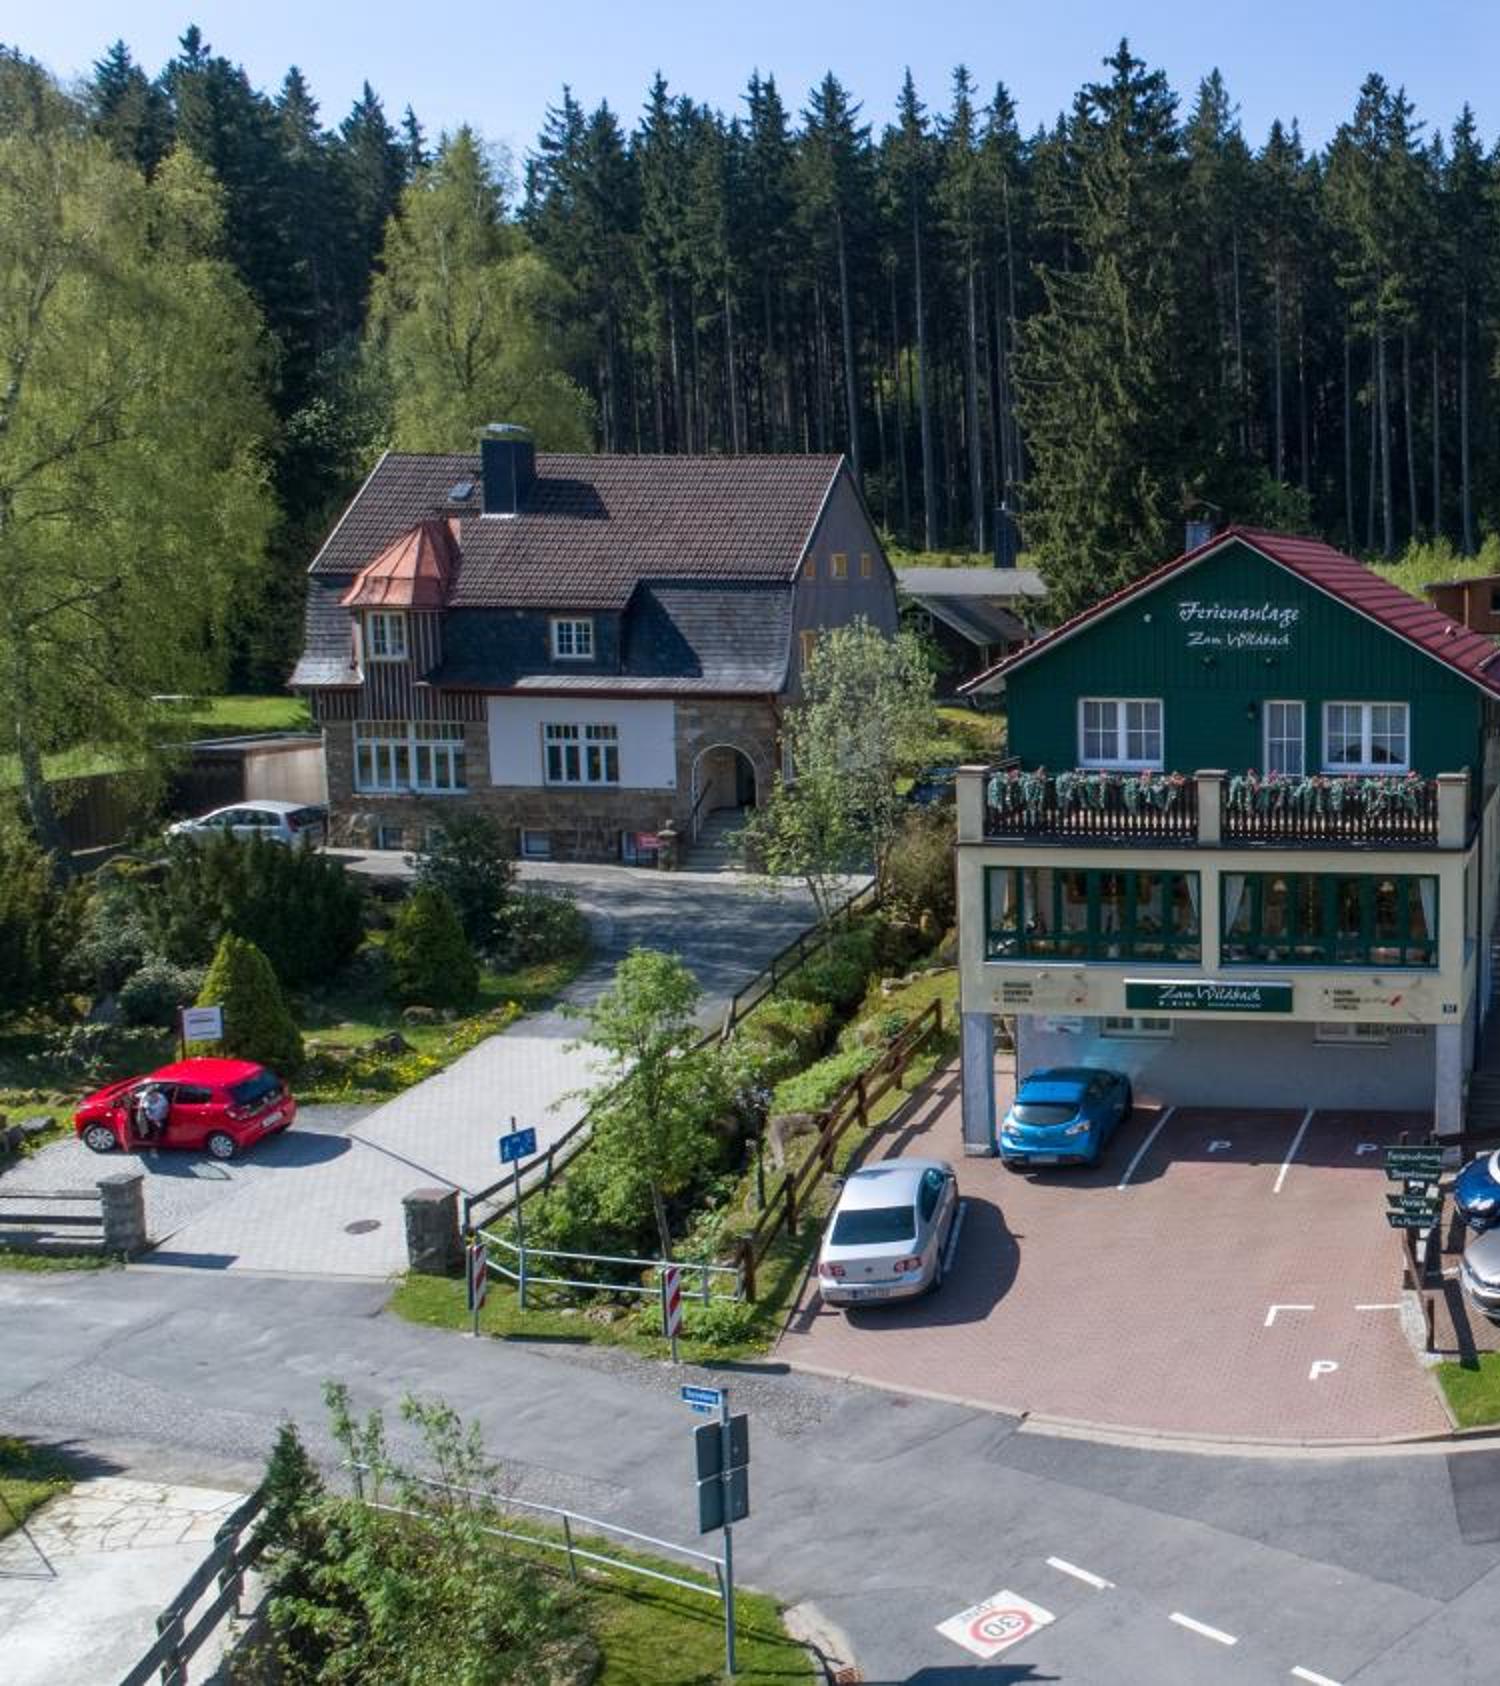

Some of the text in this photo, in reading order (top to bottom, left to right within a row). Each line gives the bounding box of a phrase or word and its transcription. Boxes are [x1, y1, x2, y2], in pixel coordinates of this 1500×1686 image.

[1178, 601, 1300, 628] Ferienanlage
[1186, 632, 1289, 648] Zum Wildbach
[1158, 986, 1261, 1001] Zum Wildbach
[1309, 1360, 1338, 1380] P
[983, 1614, 1022, 1637] 30
